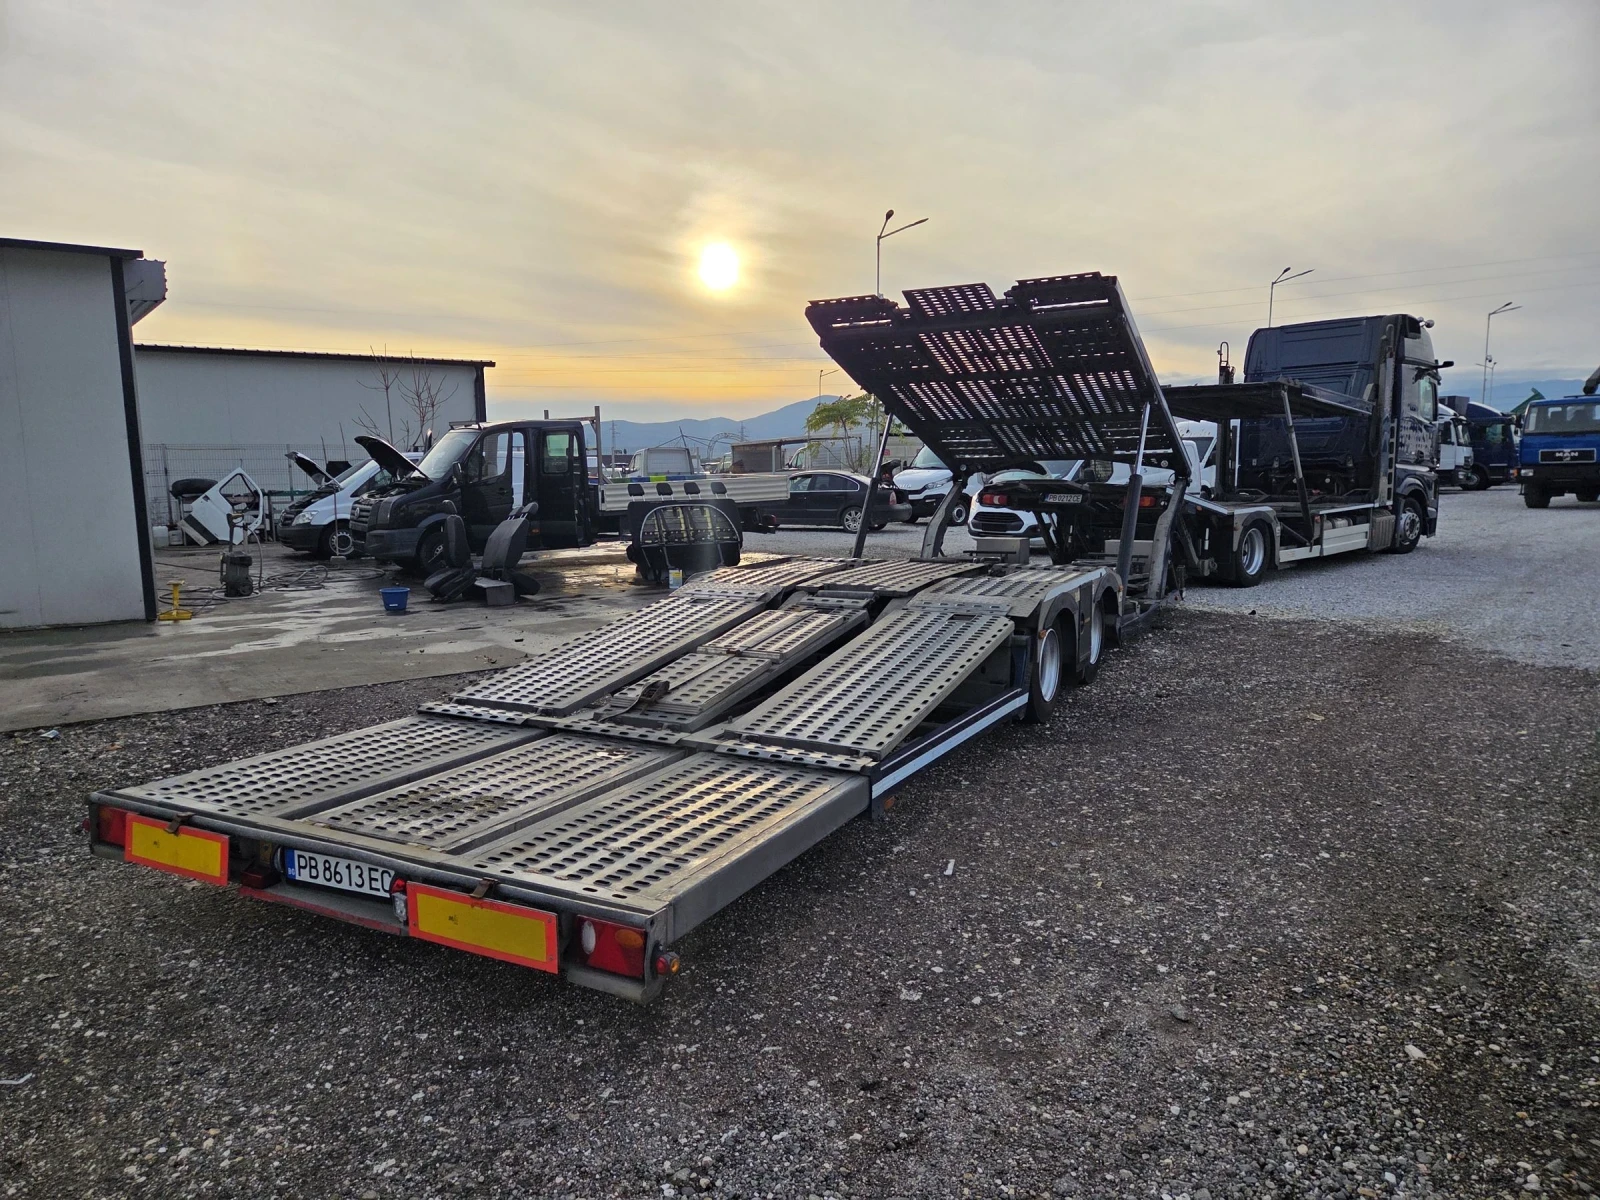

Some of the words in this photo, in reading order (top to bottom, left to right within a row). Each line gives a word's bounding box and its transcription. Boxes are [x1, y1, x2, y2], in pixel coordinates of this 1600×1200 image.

[297, 854, 319, 880] PB
[323, 859, 365, 888] 8613
[368, 866, 392, 894] EC
